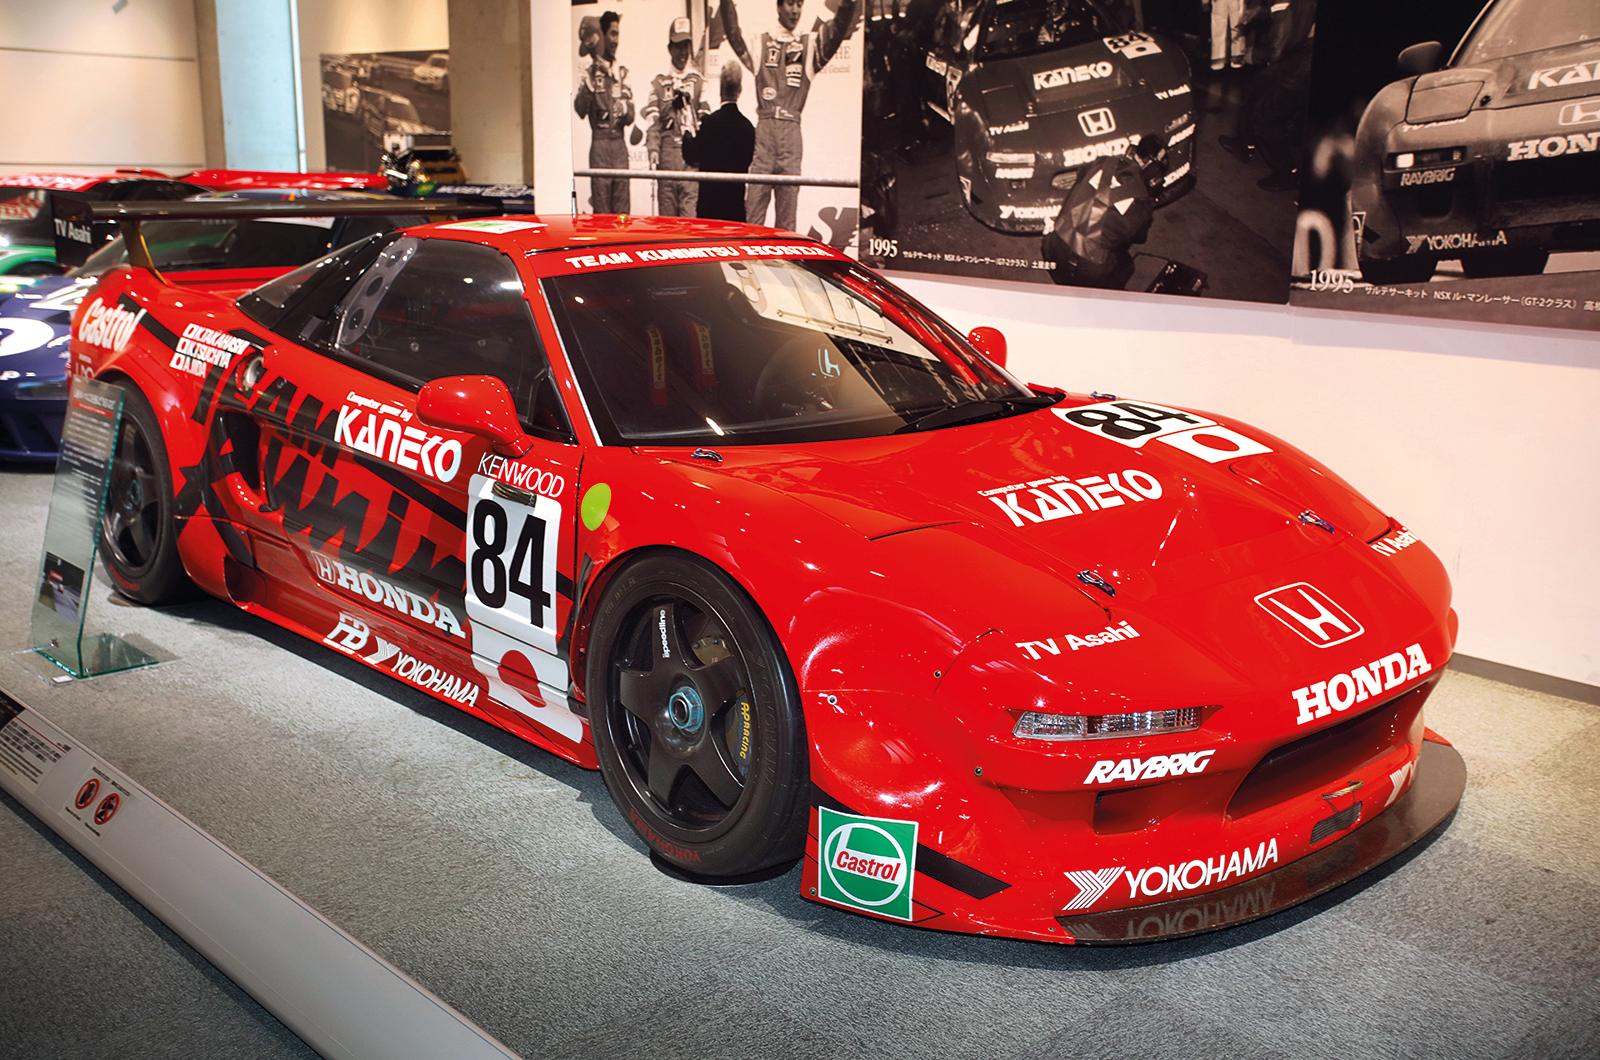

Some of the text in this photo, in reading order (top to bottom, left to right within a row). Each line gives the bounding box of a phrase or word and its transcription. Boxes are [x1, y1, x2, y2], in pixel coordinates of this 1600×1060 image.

[1033, 61, 1113, 91] KANEKO
[1527, 60, 1600, 90] KA
[1401, 167, 1456, 187] RAYBRIG
[54, 217, 92, 245] TV Asahi
[868, 238, 899, 258] 1995
[564, 245, 835, 269] TEAM KUNIMITSU HONDA
[1308, 269, 1356, 294] 1995
[1364, 285, 1428, 299] サルテサーキット
[78, 297, 147, 352] Castrol
[346, 391, 413, 422] Computer game by
[1065, 402, 1201, 441] 84
[333, 404, 463, 483] KANEKO
[477, 451, 565, 498] KENWOOD
[977, 483, 1027, 497] Computer
[1026, 478, 1055, 488] game
[988, 469, 1163, 528] KANEKO
[1370, 526, 1420, 557] TV Asahi
[471, 499, 552, 629] 84
[334, 561, 467, 639] HONDA
[658, 608, 671, 659] speedline
[1016, 620, 1141, 661] TV Asahi
[390, 651, 480, 708] YOKOHAMA
[1291, 642, 1432, 725] HONDA
[1082, 748, 1217, 786] RAYBRIG
[836, 850, 902, 882] Castrol
[1124, 837, 1279, 899] YOKOHAMA
